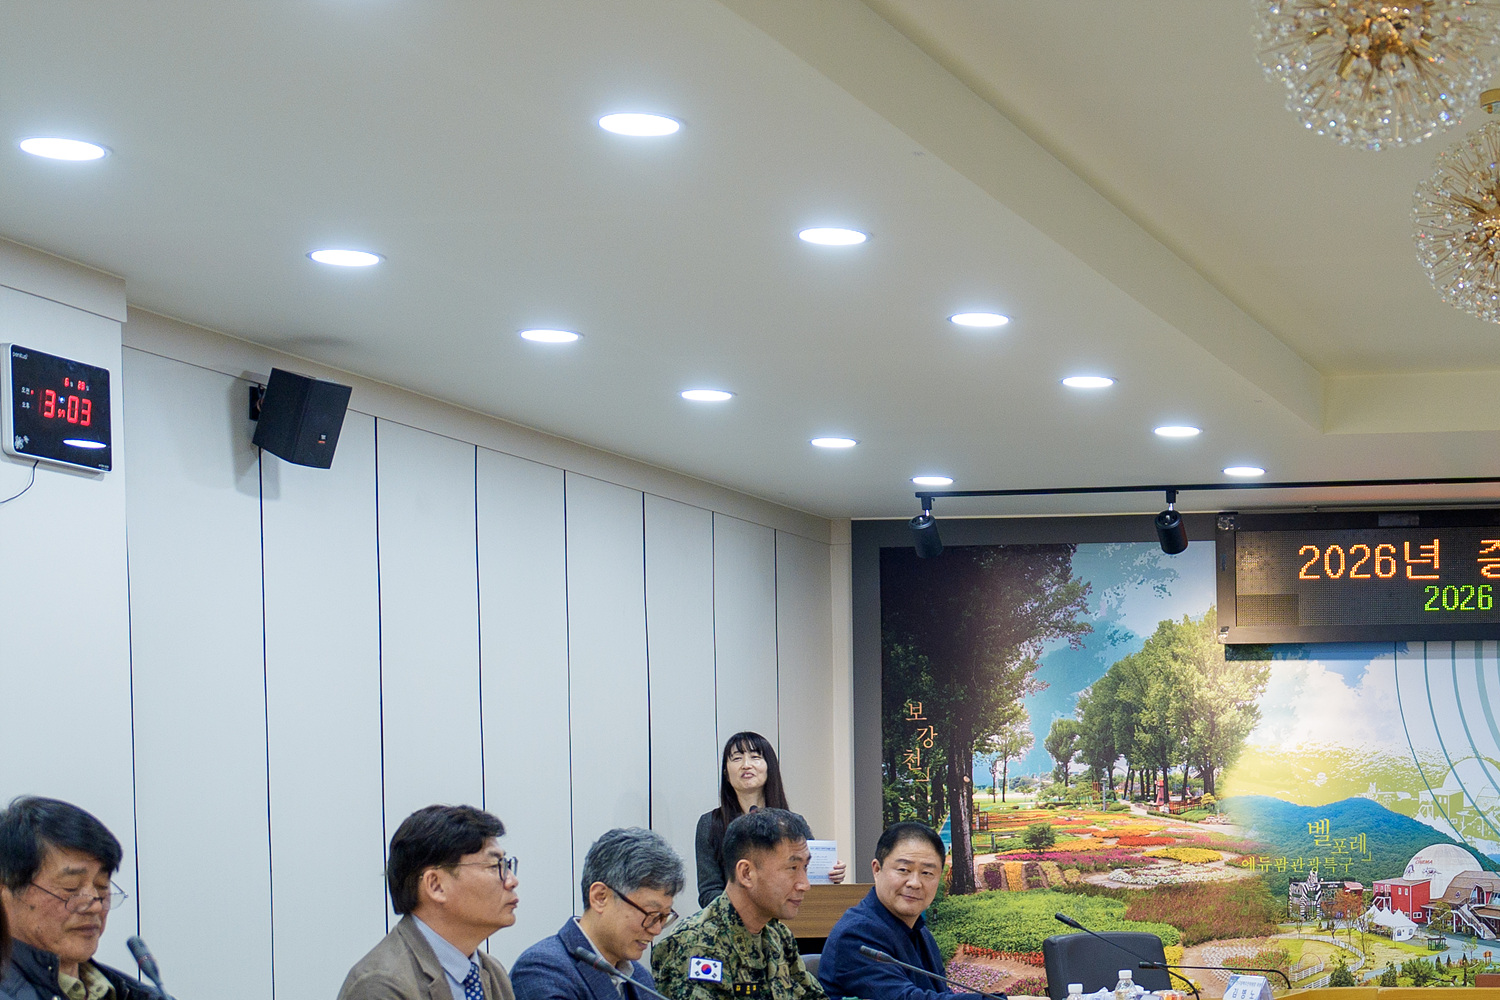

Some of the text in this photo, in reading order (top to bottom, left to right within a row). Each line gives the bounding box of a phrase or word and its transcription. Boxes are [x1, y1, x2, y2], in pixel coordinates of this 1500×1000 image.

[1298, 537, 1441, 580] 2026년
[901, 701, 938, 771] 보강천
[1307, 818, 1368, 855] 벨포레
[1241, 856, 1354, 873] 에듀팜관광특구
